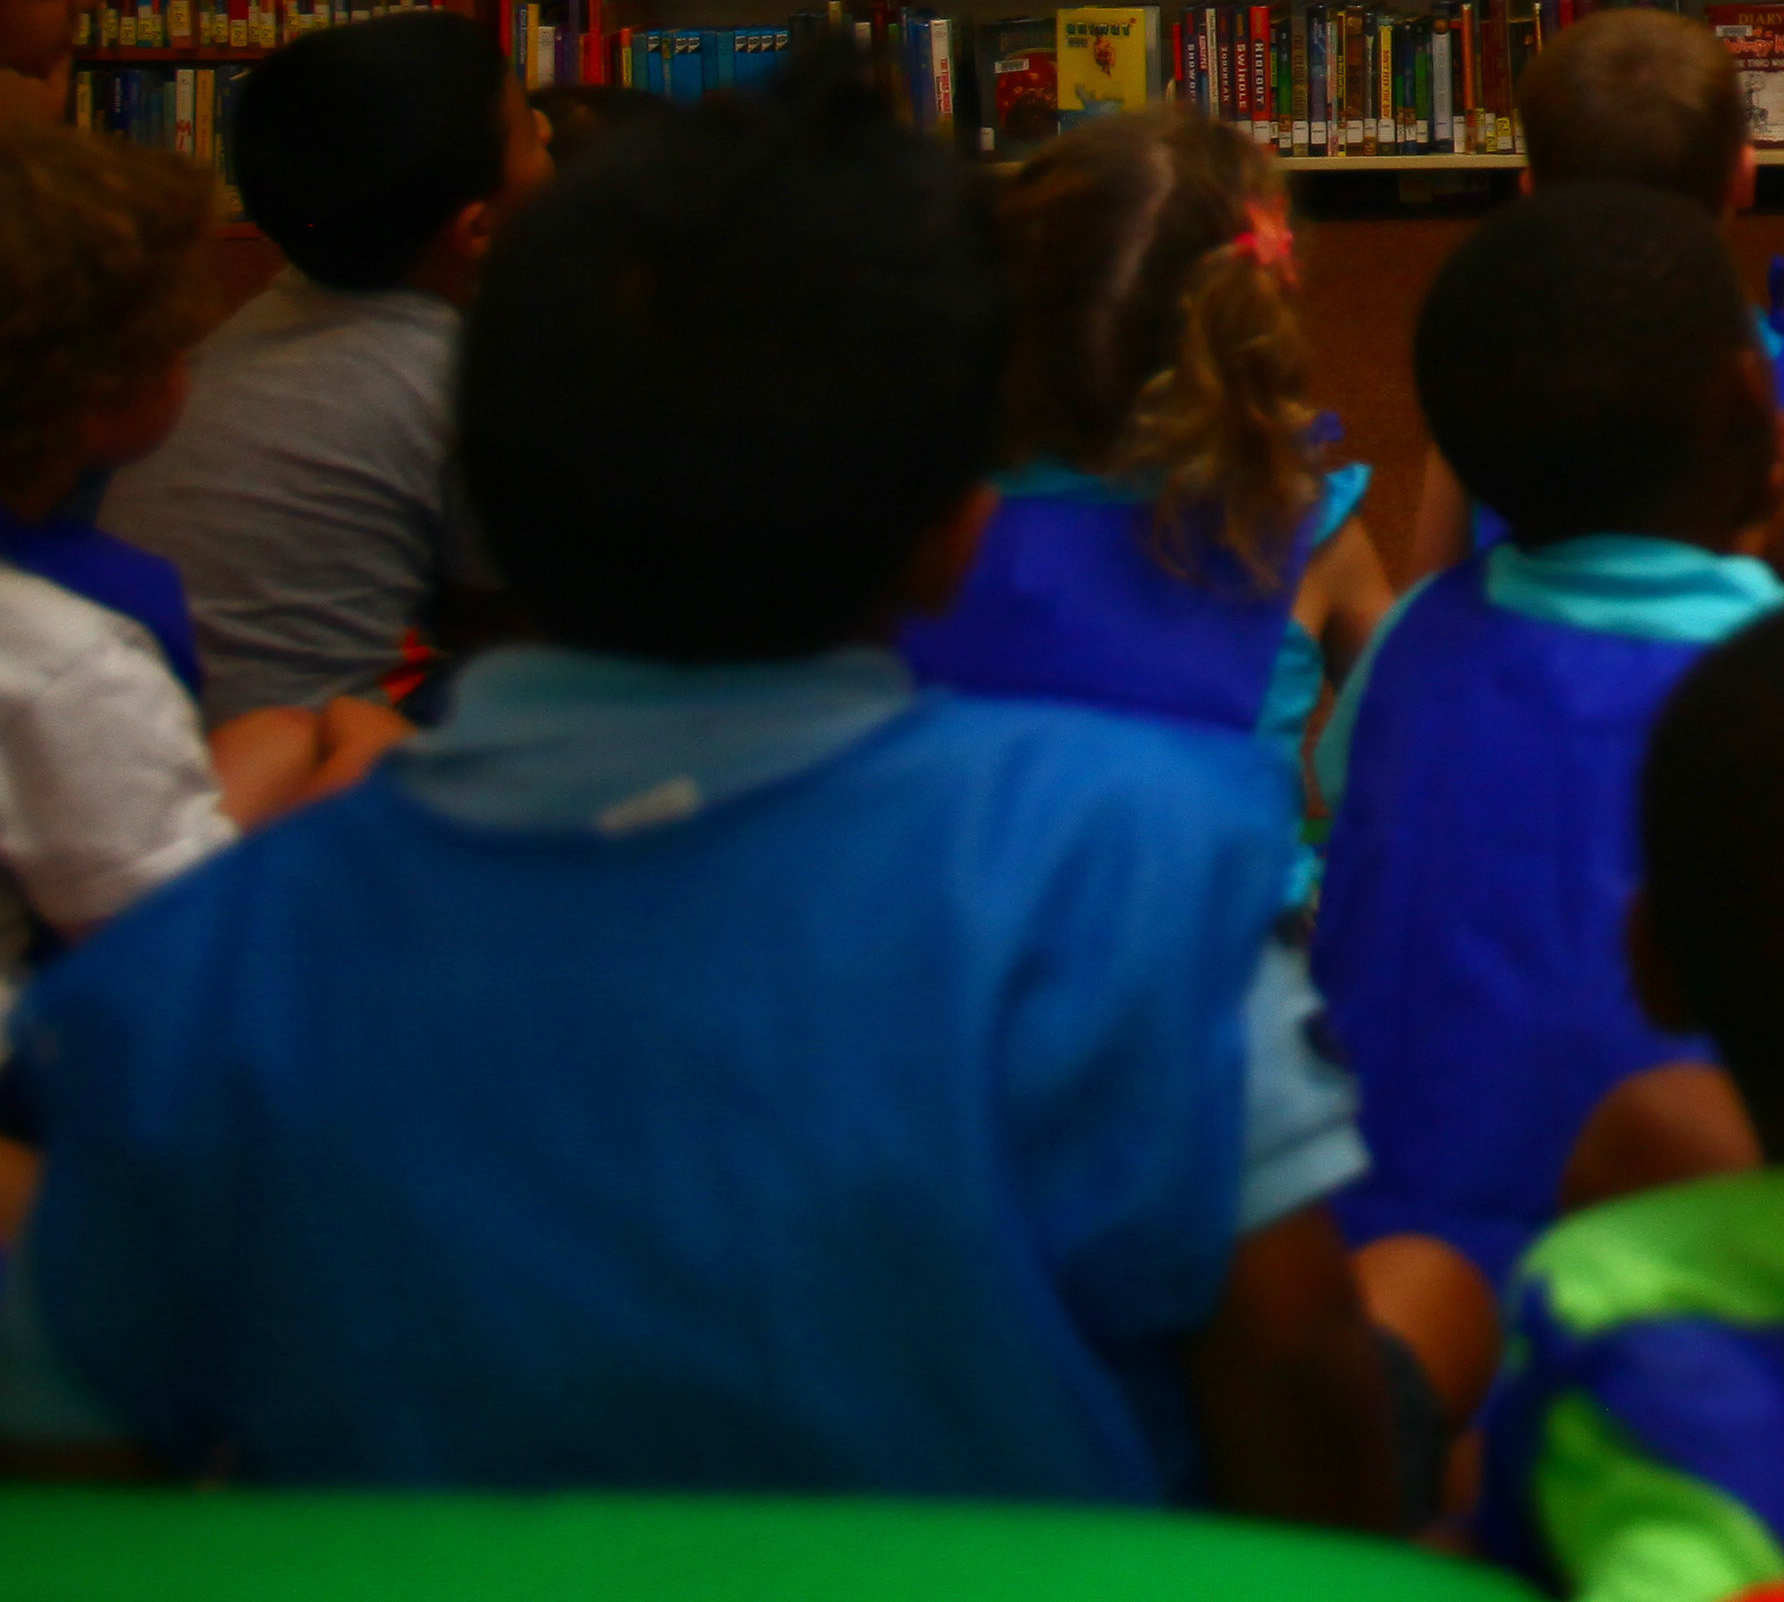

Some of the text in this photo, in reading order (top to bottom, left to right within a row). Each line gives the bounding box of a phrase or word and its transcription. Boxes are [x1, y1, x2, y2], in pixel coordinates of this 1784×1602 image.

[1739, 14, 1784, 24] DIARY
[1221, 45, 1231, 102] ZOOBREAK
[1236, 43, 1247, 109] SWINDLE
[1254, 42, 1265, 105] HIDEOUT
